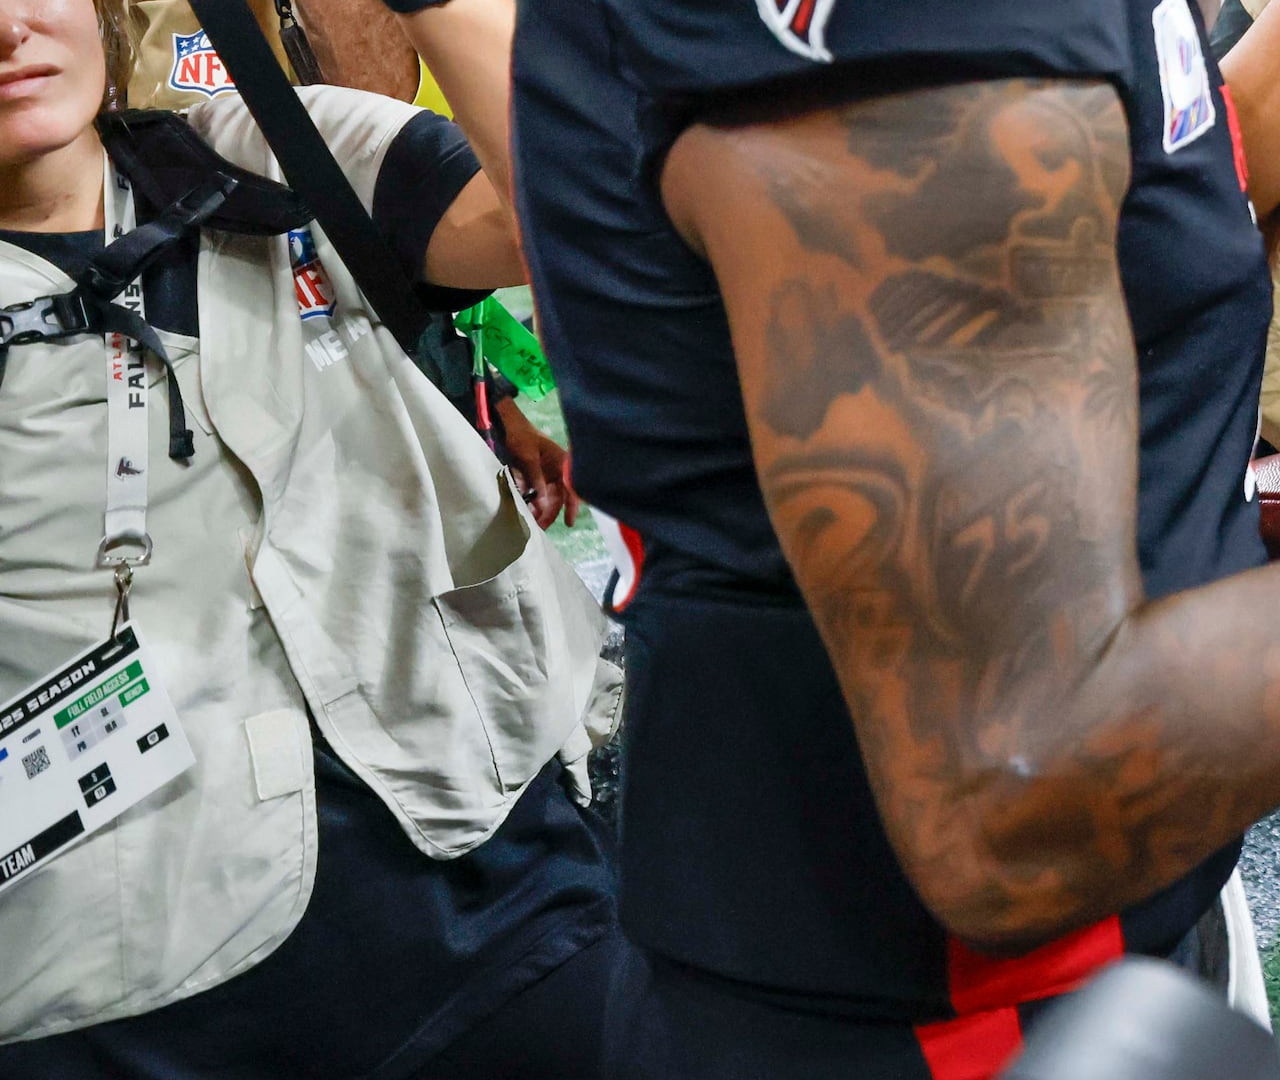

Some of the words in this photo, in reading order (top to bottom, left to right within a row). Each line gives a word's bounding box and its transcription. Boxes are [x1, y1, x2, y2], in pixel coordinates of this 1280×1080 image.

[179, 51, 234, 88] NF
[293, 260, 328, 311] NF
[124, 283, 146, 410] FALCNS
[0, 707, 25, 732] 25
[26, 660, 96, 713] SEASON
[67, 700, 86, 719] FULL
[83, 686, 104, 708] FIELD
[102, 670, 130, 696] ACCESS
[0, 843, 36, 879] TEAM
